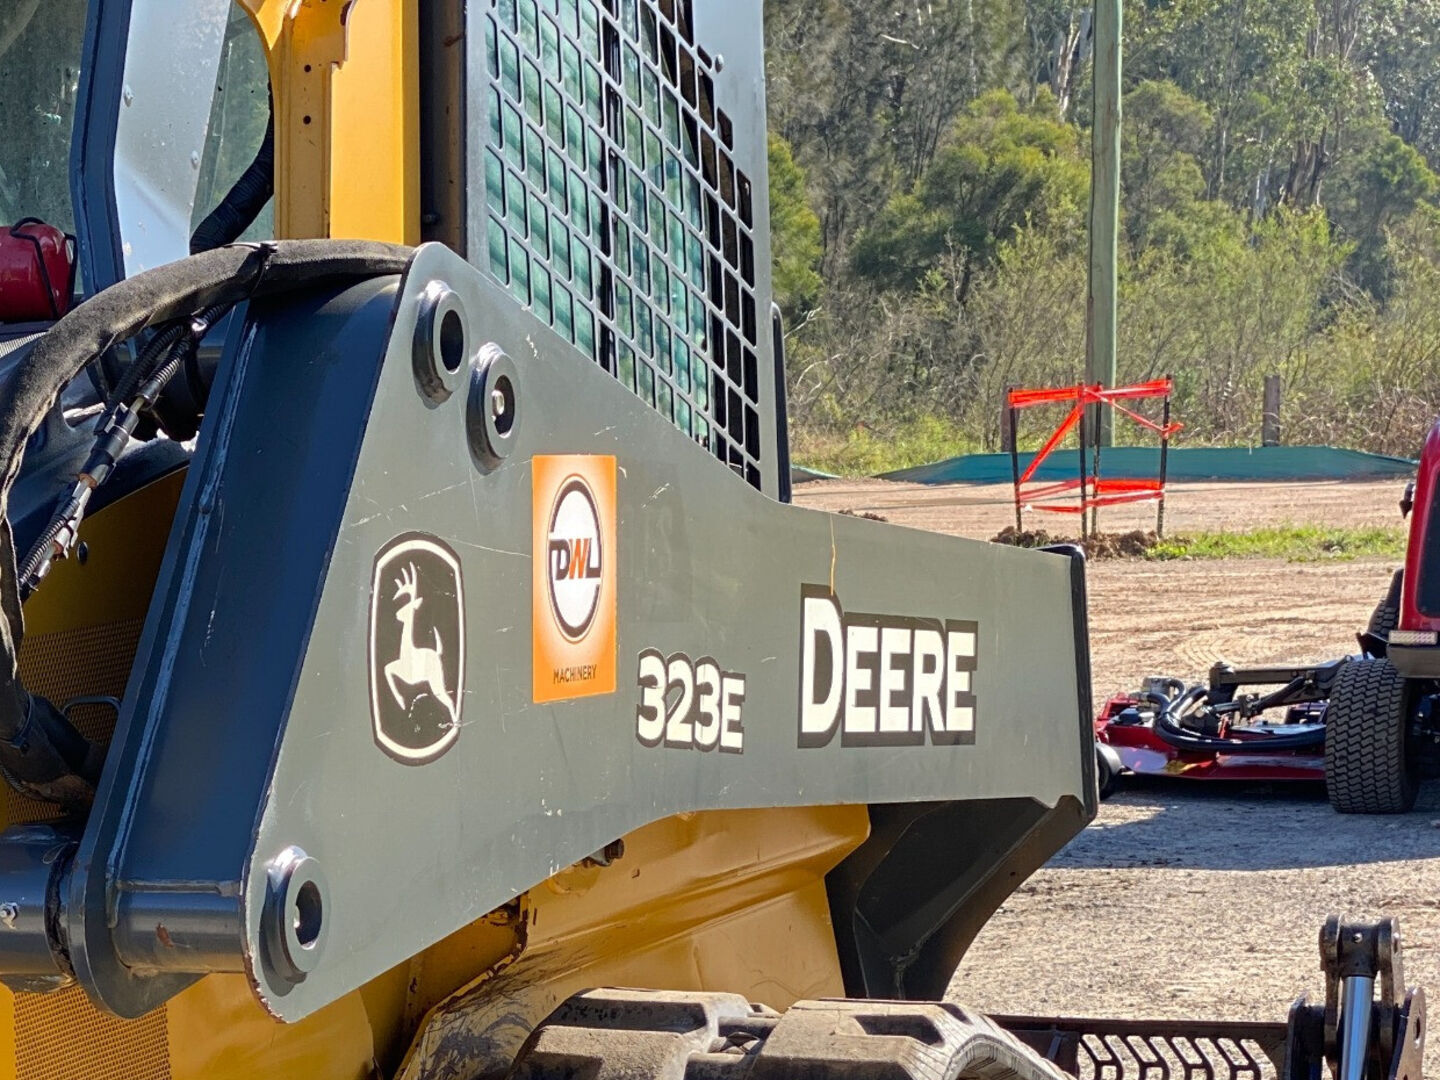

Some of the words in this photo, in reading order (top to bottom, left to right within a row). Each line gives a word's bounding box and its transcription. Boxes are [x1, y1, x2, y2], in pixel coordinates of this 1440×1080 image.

[549, 538, 601, 580] DWL
[553, 663, 597, 685] MACHINERY
[636, 650, 745, 753] 323E
[799, 586, 977, 746] DEERE
